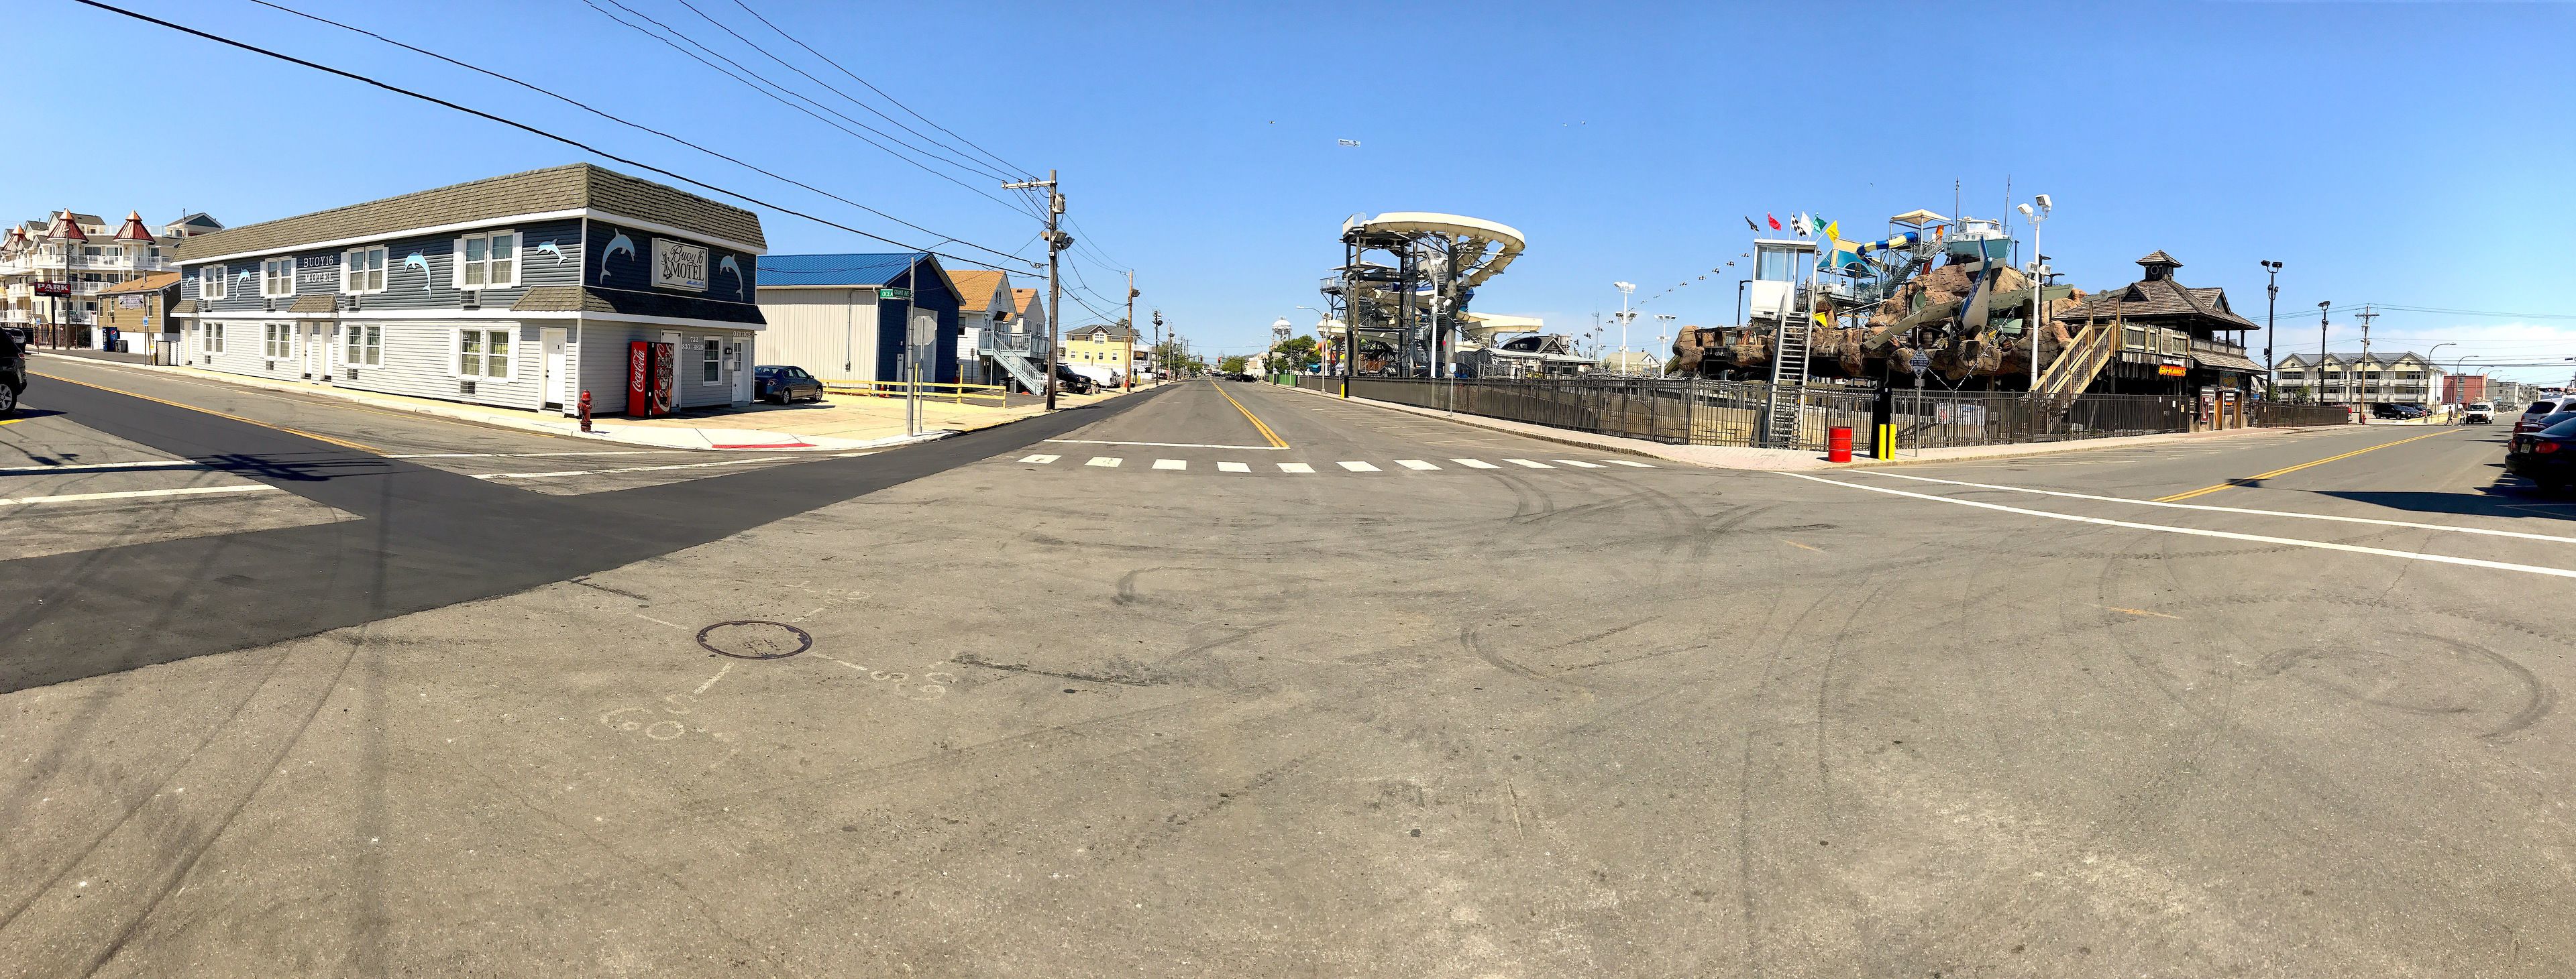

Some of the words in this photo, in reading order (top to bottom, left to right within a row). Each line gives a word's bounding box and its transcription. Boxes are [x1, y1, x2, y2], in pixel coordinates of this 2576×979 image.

[667, 245, 696, 263] Buoy
[696, 250, 704, 264] 16
[305, 272, 334, 283] MOTEL
[671, 262, 704, 281] MOTEL
[38, 283, 69, 291] PARK
[632, 347, 645, 392] Coca-Cola
